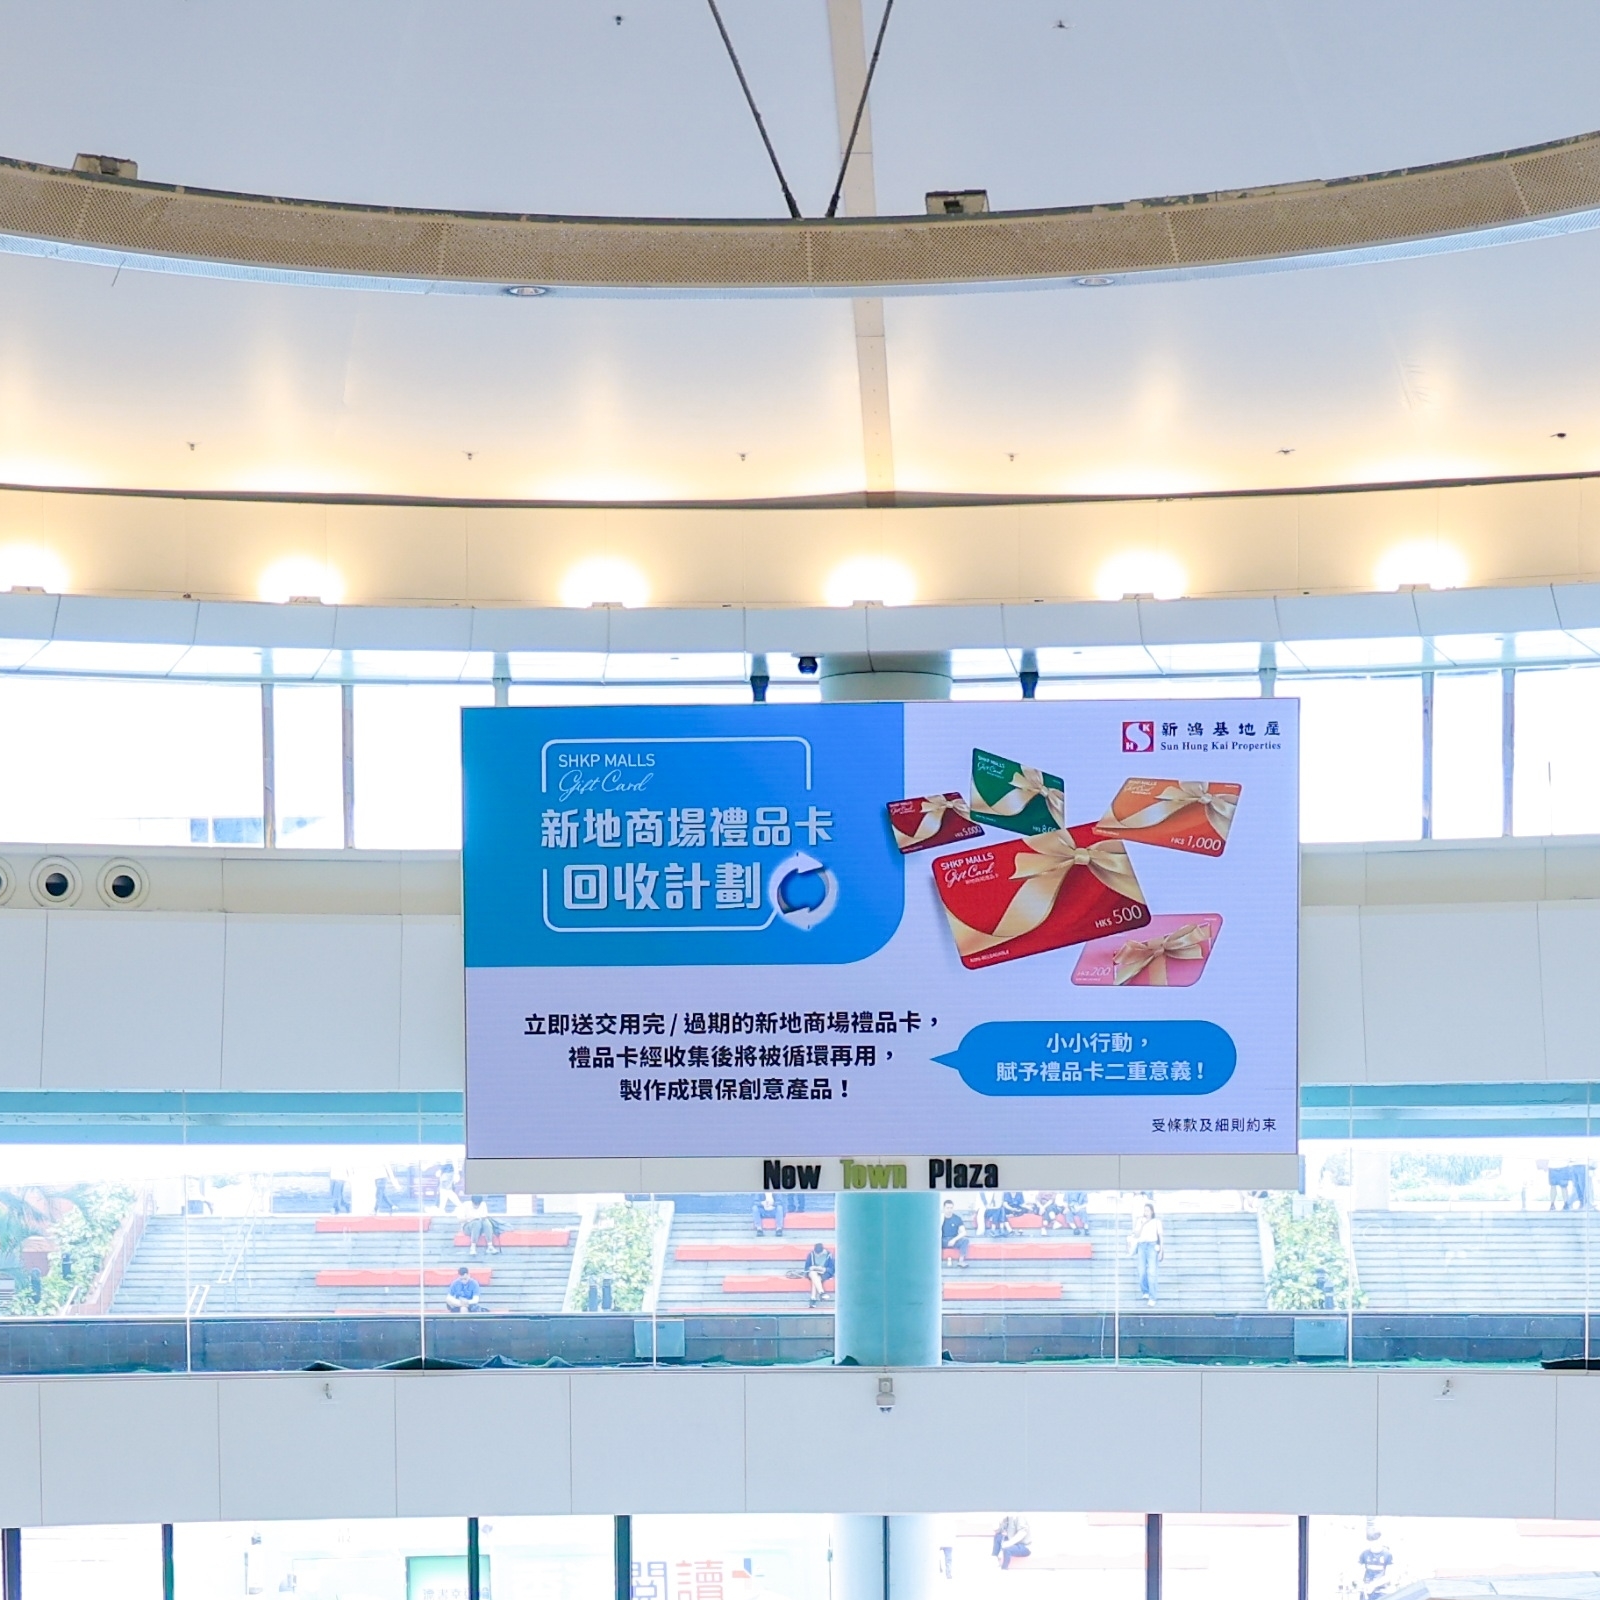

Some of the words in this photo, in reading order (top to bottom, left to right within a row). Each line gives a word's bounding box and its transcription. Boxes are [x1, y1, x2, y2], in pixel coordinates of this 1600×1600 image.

[1161, 721, 1281, 738] 新鴻基地產
[1160, 740, 1179, 752] Sun
[1182, 740, 1208, 754] Hung
[1211, 740, 1229, 752] Kai
[1232, 739, 1281, 753] Properties
[558, 754, 601, 768] SHKP
[604, 753, 656, 768] MALLS
[558, 769, 600, 801] Gift
[600, 769, 654, 792] Card
[541, 805, 833, 848] 新地商場禮品卡
[1170, 836, 1187, 846] HK$
[1186, 834, 1223, 852] 1,000
[940, 857, 965, 871] SHKP
[965, 851, 995, 867] MALLS
[563, 861, 761, 911] 回收計劃
[1094, 916, 1113, 930] HK$
[1112, 904, 1144, 926] 500
[1089, 965, 1112, 977] 200
[524, 1012, 665, 1036] 立即送交用完
[684, 1010, 938, 1035] 過期的新地商場禮品卡，
[1046, 1032, 1150, 1054] 小小行動，
[568, 1044, 894, 1069] 禮品卡經收集後將被循環再用，
[996, 1060, 1205, 1083] 賦予禮品卡二重意義！
[619, 1077, 849, 1102] 製作成環保創意產品！
[1152, 1117, 1277, 1134] 受條款及細則約束
[763, 1158, 822, 1191] New
[840, 1158, 908, 1189] Town
[928, 1157, 1000, 1189] Plaza
